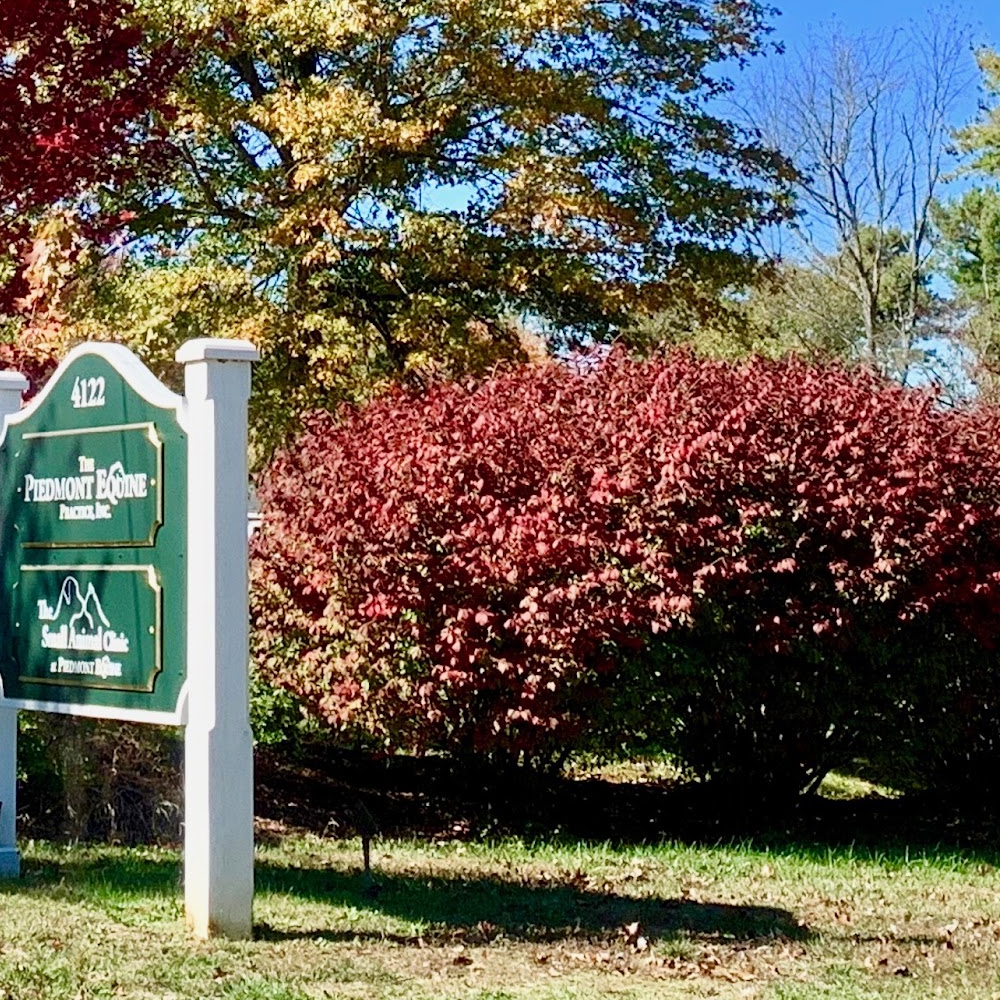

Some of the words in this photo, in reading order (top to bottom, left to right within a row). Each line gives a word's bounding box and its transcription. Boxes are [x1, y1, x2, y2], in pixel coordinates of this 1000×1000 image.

[70, 376, 106, 409] 4122
[78, 455, 95, 473] THE
[24, 474, 95, 502] PIEDMONT
[95, 462, 148, 504] EQUINE
[37, 599, 54, 620] The
[41, 624, 68, 649] Small
[68, 626, 103, 651] Animal
[103, 630, 129, 653] Clinic
[58, 656, 95, 675] PIEDMONT
